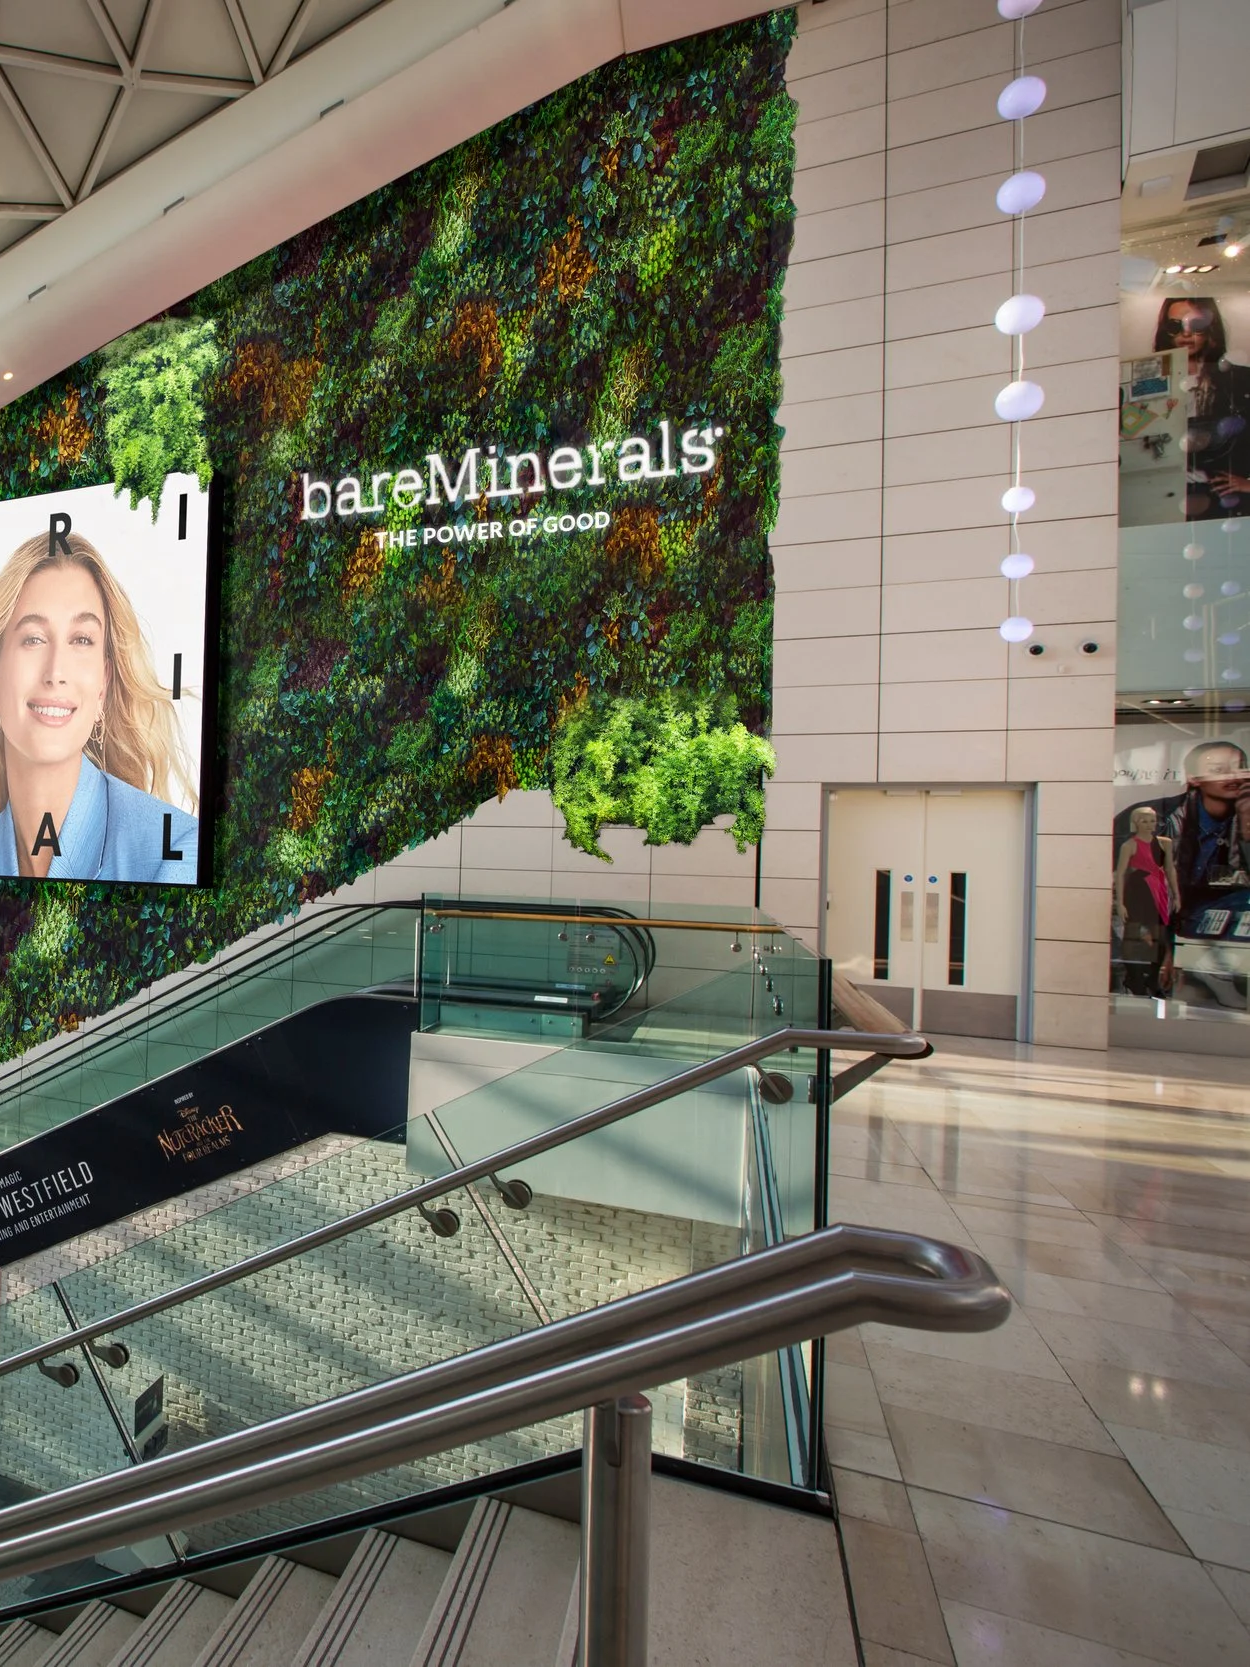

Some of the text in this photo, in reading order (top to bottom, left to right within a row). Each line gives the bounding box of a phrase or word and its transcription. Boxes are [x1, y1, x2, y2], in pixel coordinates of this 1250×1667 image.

[301, 420, 716, 520] bareMinerals
[49, 512, 73, 557] R
[374, 511, 610, 549] THE POWER OF GOOD
[31, 812, 62, 857] A
[162, 813, 183, 861] L
[157, 1105, 244, 1161] NUTCRACKER
[15, 1219, 30, 1233] AND
[30, 1193, 91, 1229] ENTERTAINMENT
